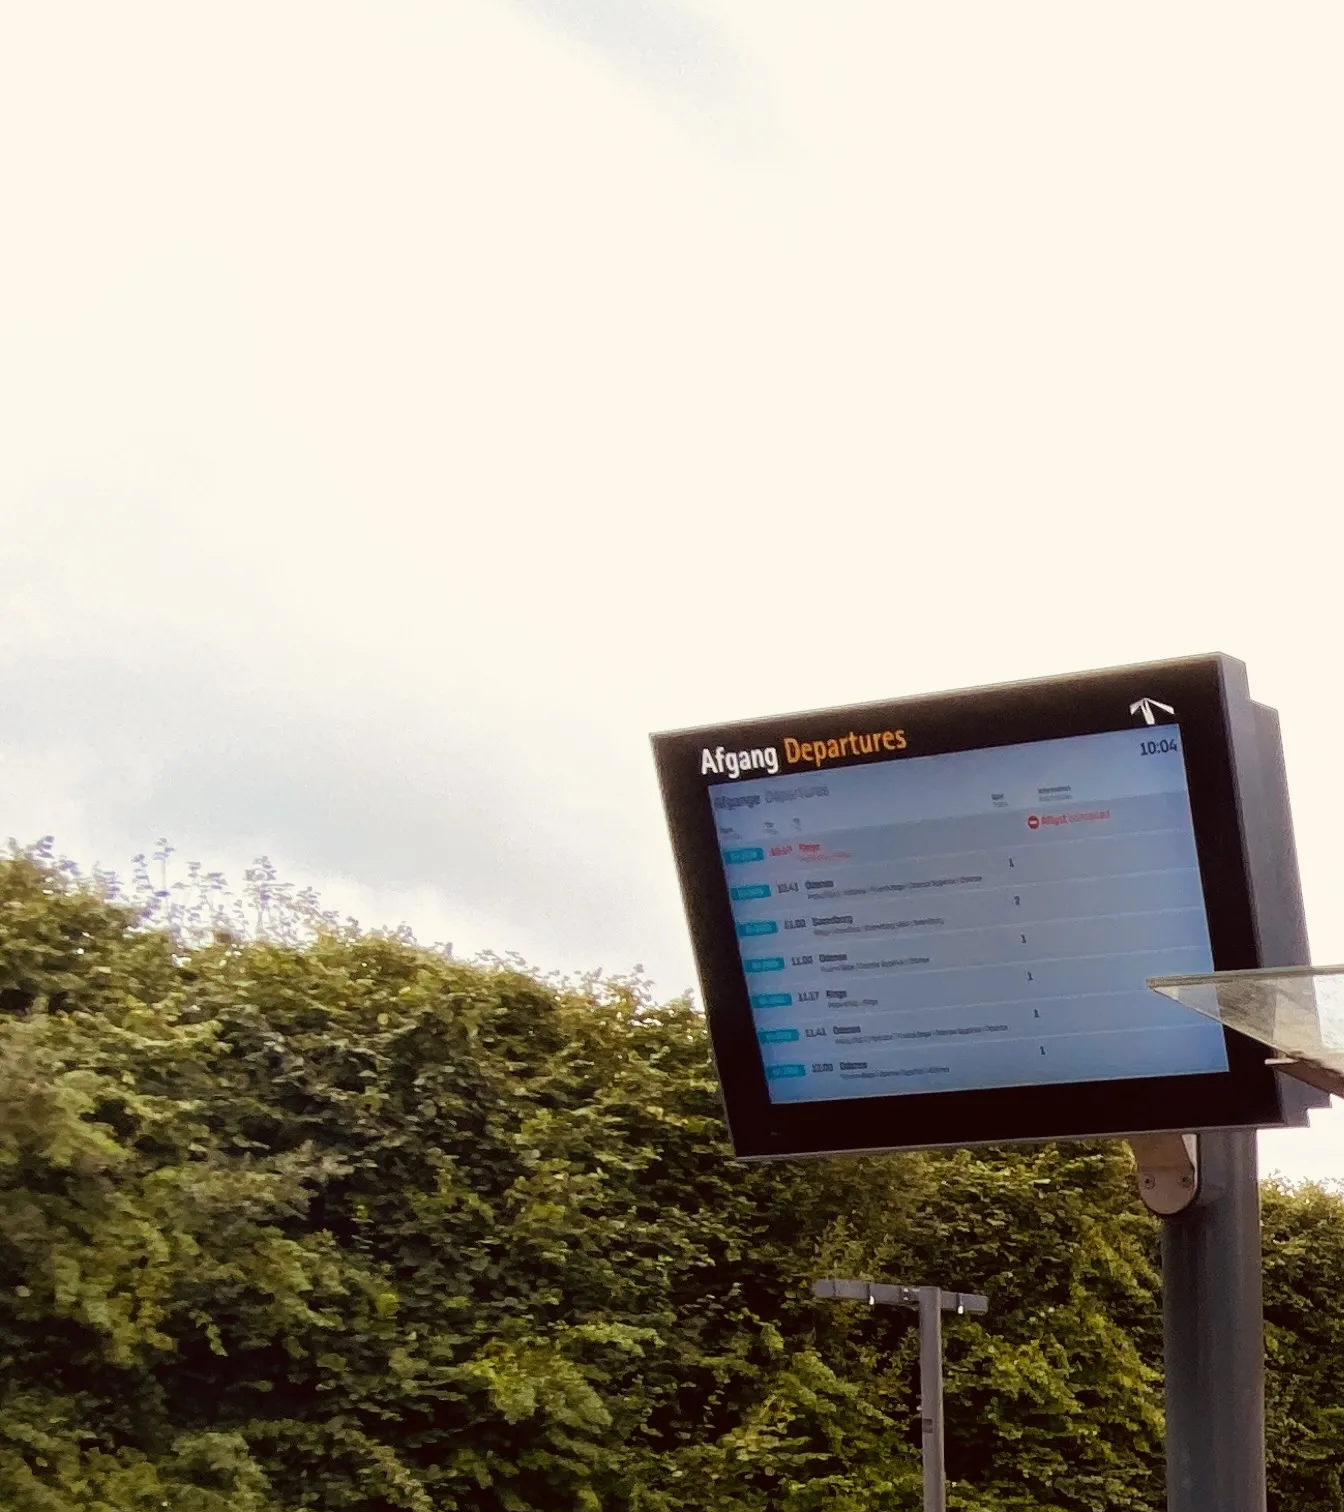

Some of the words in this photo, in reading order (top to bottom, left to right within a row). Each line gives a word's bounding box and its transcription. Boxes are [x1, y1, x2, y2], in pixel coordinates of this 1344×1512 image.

[701, 746, 779, 779] Afgang
[783, 729, 907, 767] Departures
[1140, 739, 1178, 756] 10:04
